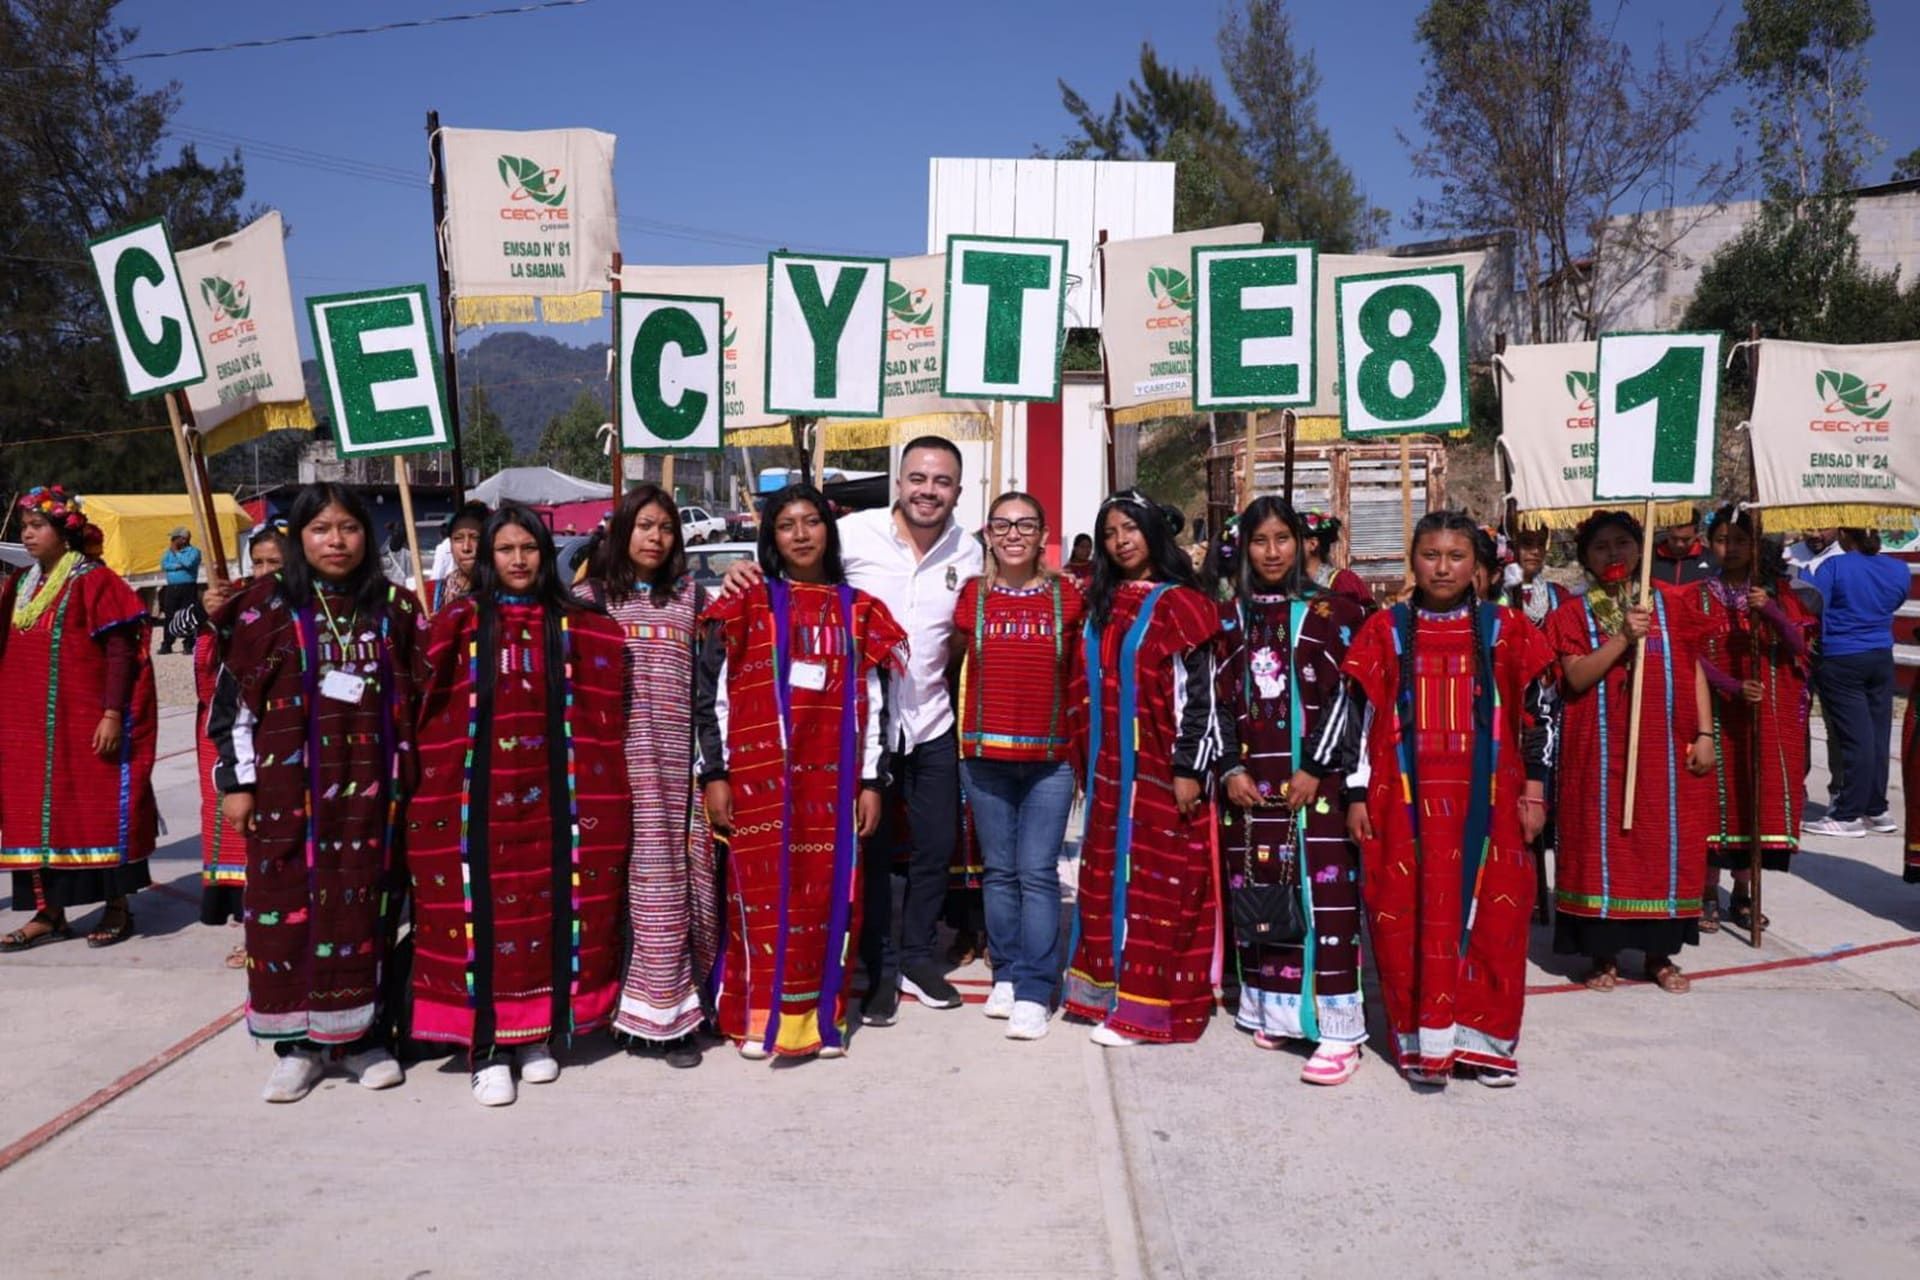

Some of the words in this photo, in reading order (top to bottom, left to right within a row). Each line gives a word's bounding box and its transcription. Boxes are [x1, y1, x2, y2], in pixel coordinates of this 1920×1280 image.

[503, 241, 541, 257] EMSAD
[511, 263, 524, 278] LA
[526, 263, 566, 278] SABANA
[114, 248, 183, 378] C
[785, 264, 869, 398] Y
[962, 250, 1051, 384] T
[1168, 340, 1190, 355] EMS
[1208, 254, 1299, 398] E
[324, 297, 435, 445] E
[630, 307, 708, 441] C
[886, 359, 907, 376] SAD
[923, 356, 937, 372] 42
[1357, 284, 1447, 421] 8
[1571, 443, 1596, 459] EMS
[1615, 346, 1705, 484] 1
[1563, 466, 1578, 481] SAN
[1802, 474, 1825, 488] SANTO
[1810, 453, 1853, 468] EMSAD
[1872, 454, 1888, 469] 24
